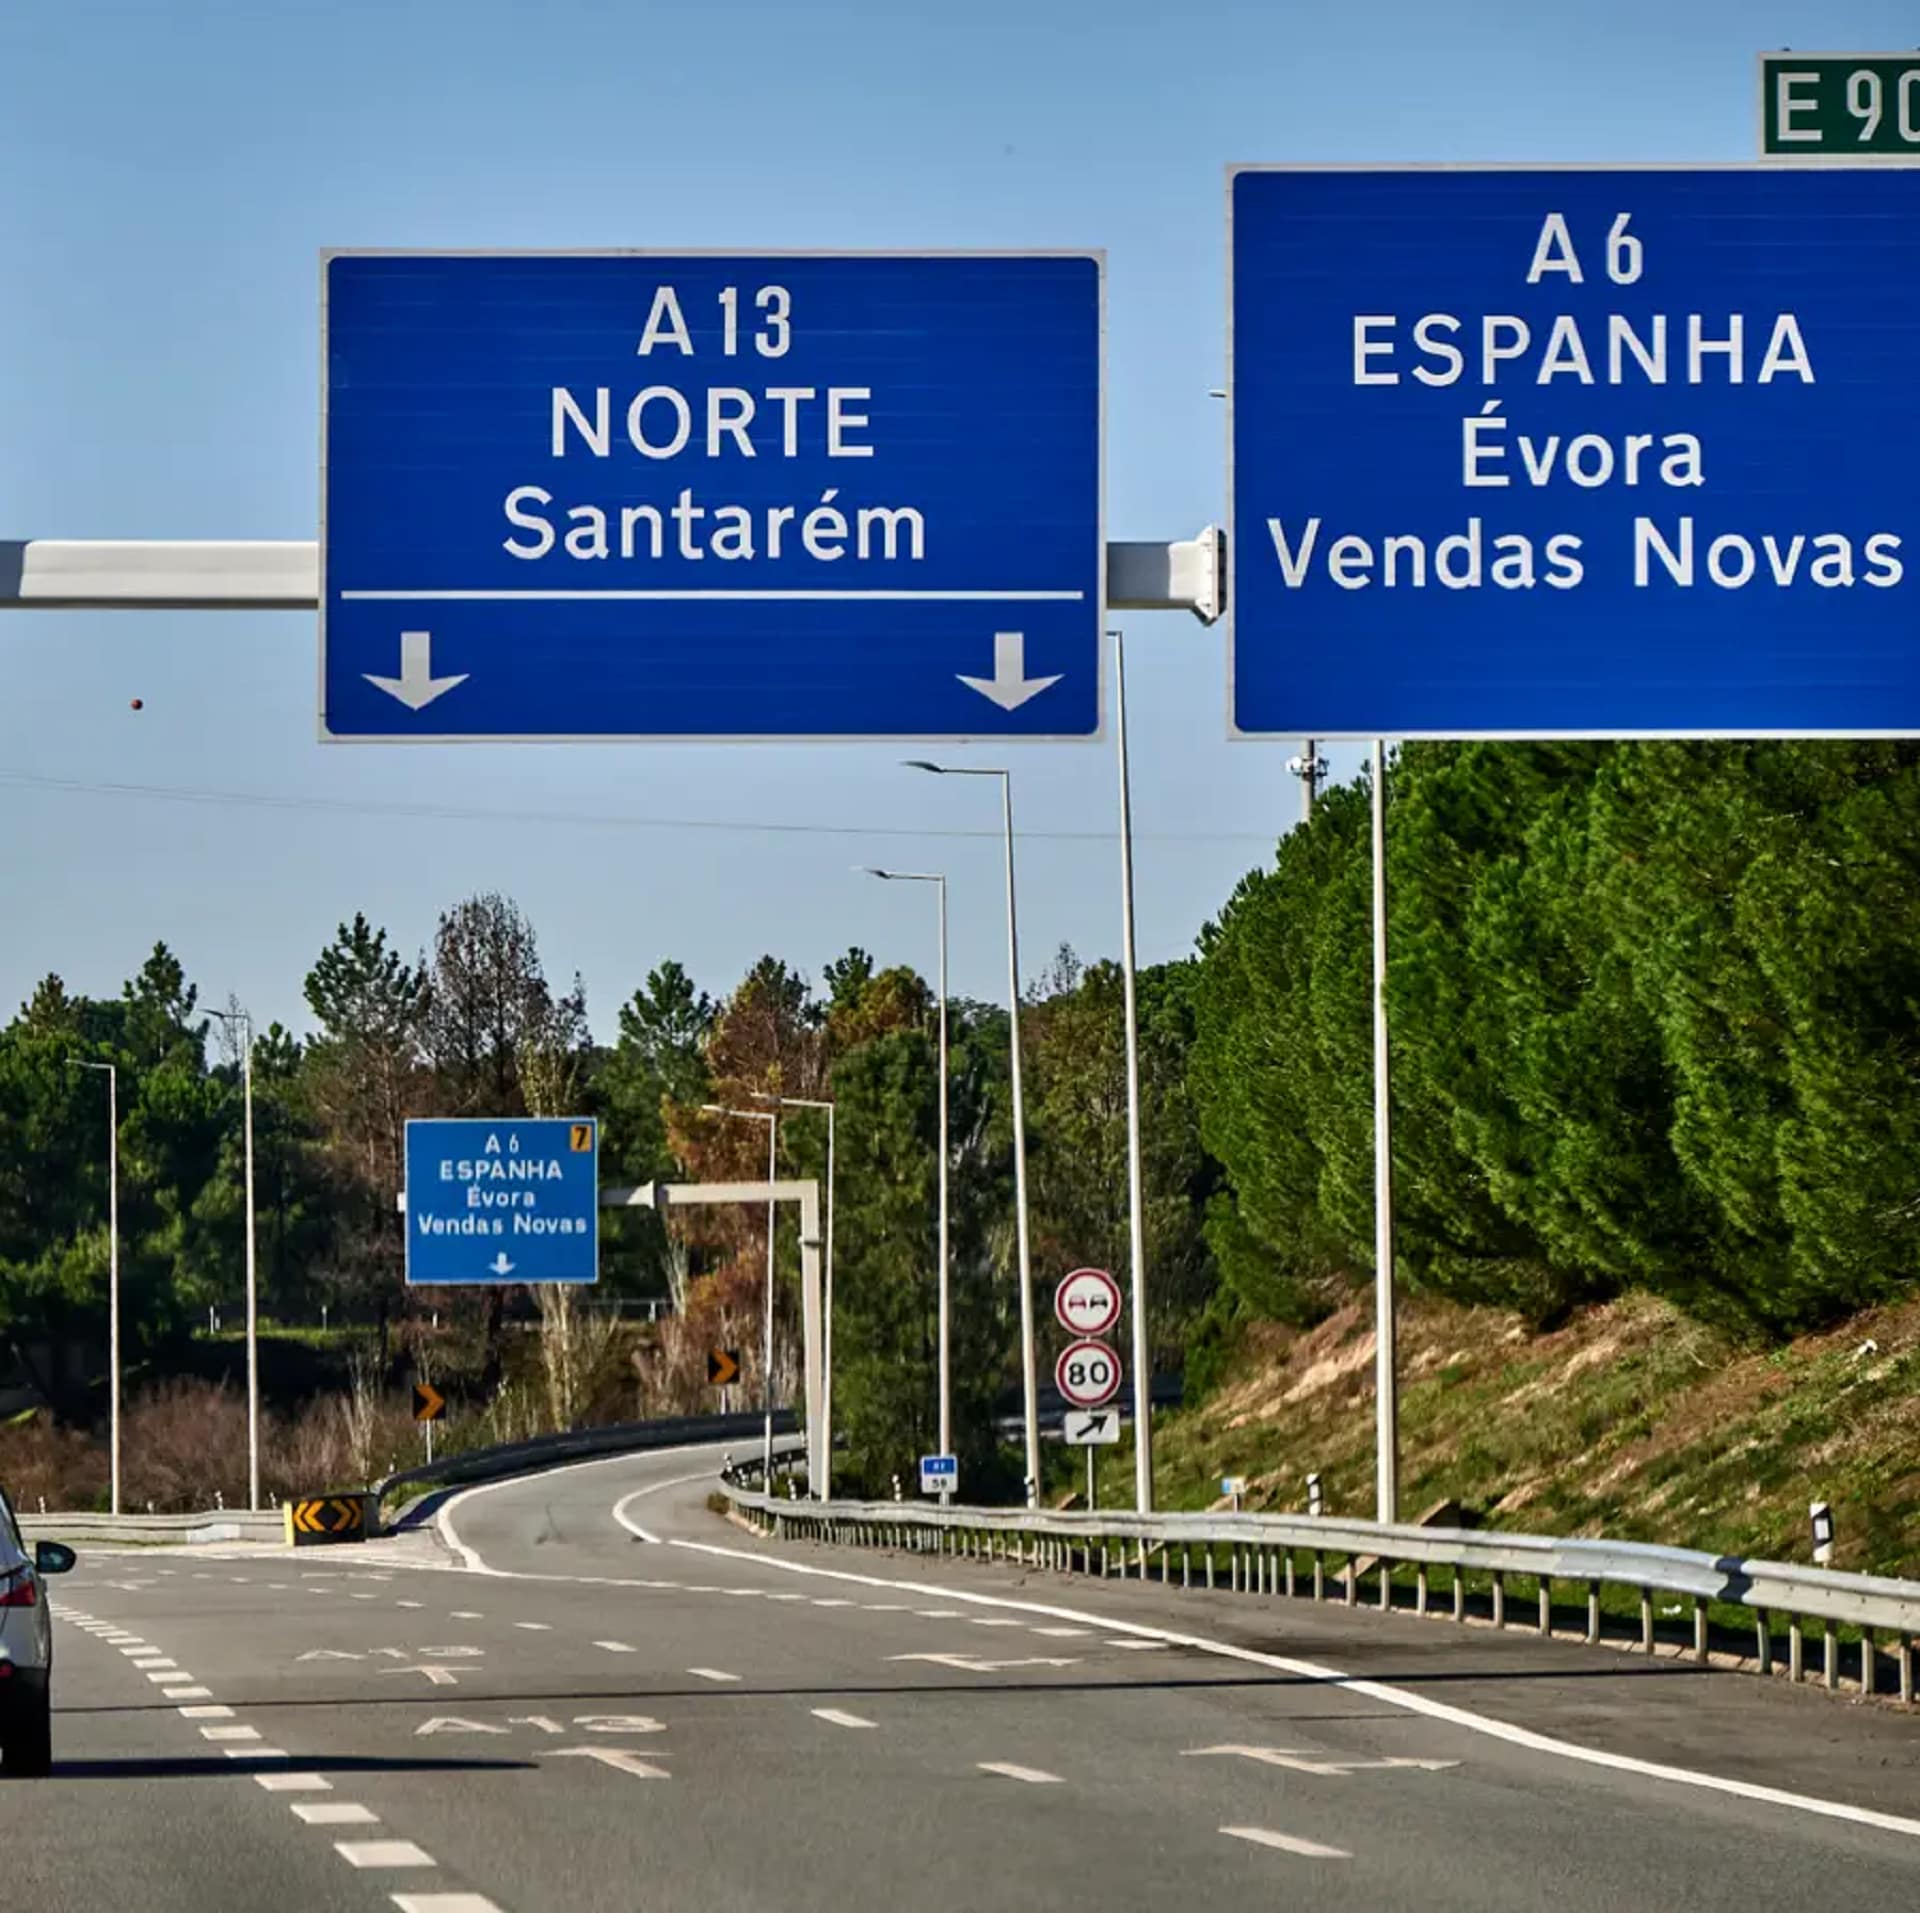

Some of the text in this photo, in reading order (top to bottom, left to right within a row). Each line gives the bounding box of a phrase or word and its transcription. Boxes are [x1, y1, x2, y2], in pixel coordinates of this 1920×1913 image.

[1777, 72, 1822, 141] E
[1526, 212, 1643, 285] A 6
[638, 286, 791, 358] A 13
[1354, 313, 1815, 387] ESPANHA
[552, 386, 874, 459] NORTE
[1463, 400, 1706, 487] Évora
[502, 485, 925, 560] Santarém
[1267, 516, 1904, 590] Vendas Novas
[440, 1160, 563, 1180] ESPANHA
[485, 1133, 520, 1154] A 6
[574, 1126, 588, 1149] 7
[418, 1212, 587, 1235] Vendas Novas
[466, 1183, 535, 1208] Évora
[1069, 1361, 1110, 1386] 80
